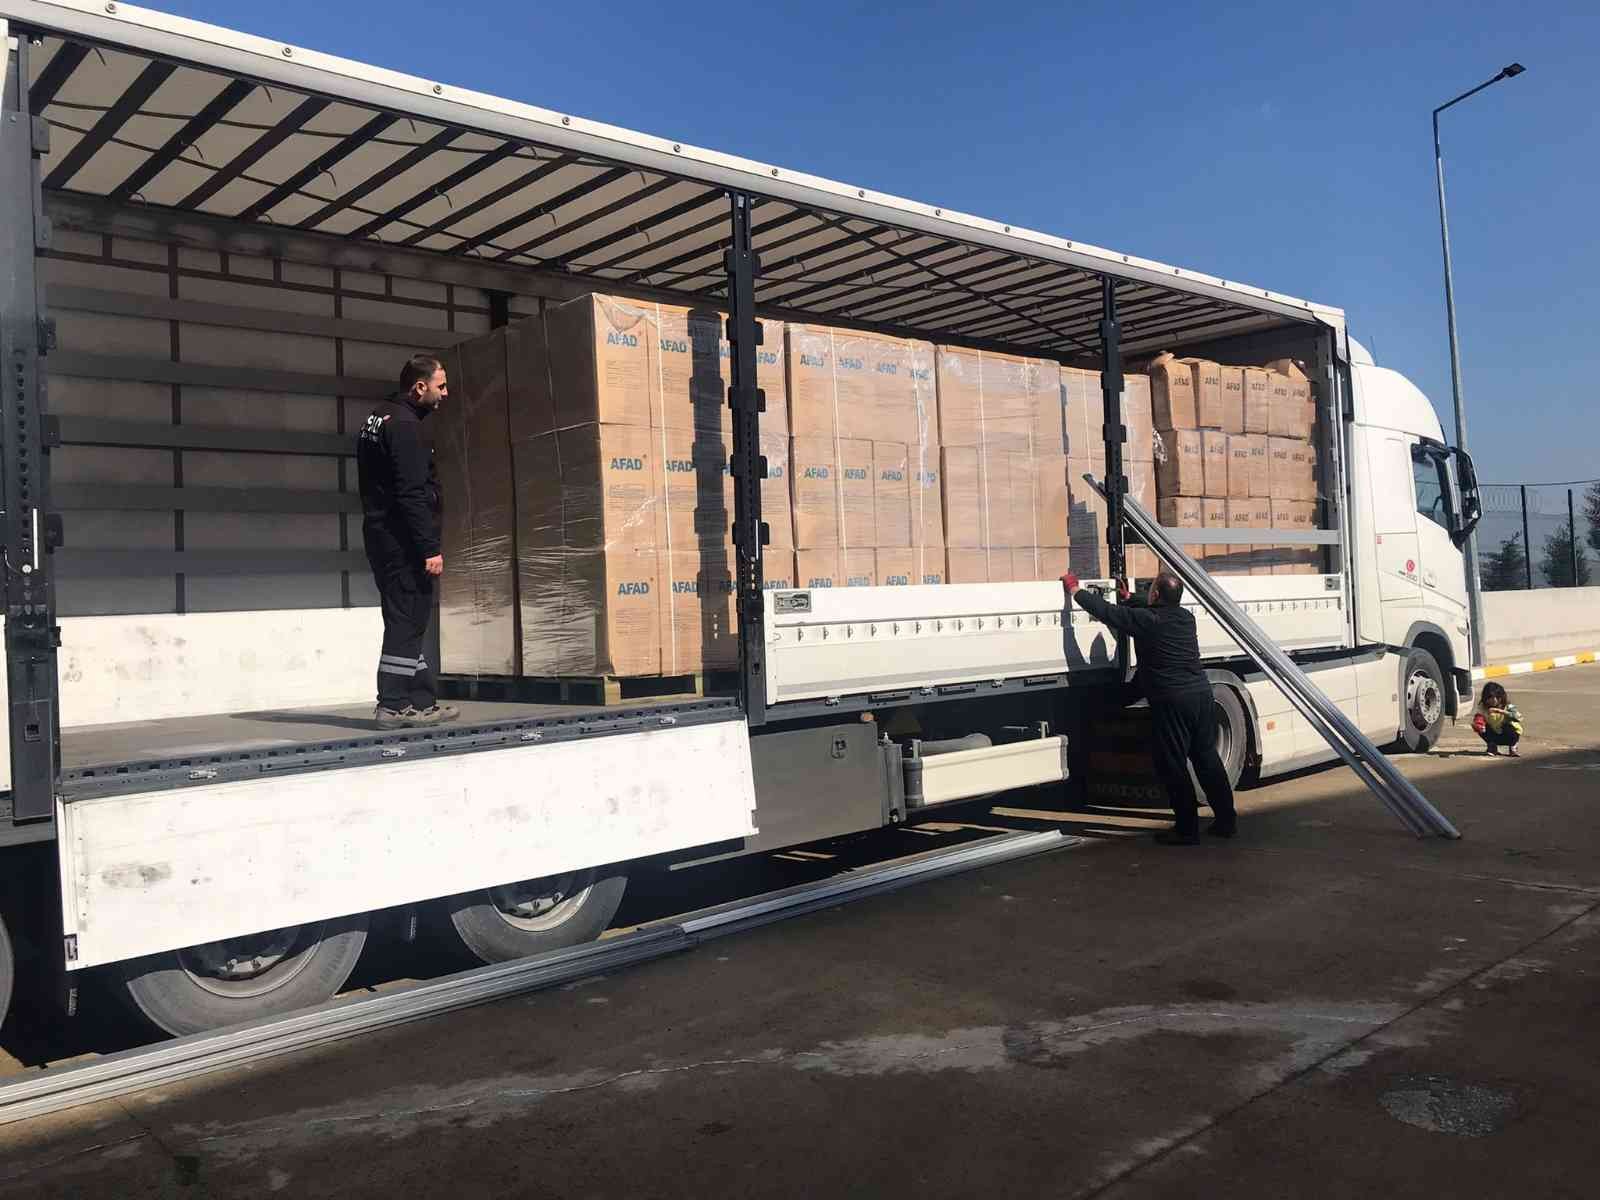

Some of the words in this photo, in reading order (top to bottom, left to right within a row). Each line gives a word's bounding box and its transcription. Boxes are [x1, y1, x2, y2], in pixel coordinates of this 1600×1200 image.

[607, 333, 637, 348] AFAD
[660, 339, 688, 353] AFAD
[757, 352, 776, 364] FAD
[611, 458, 642, 471] AFAD
[665, 460, 693, 472] AFAD
[804, 467, 829, 480] AFAD
[845, 468, 866, 480] AFAD
[881, 471, 902, 481] AFAD
[808, 578, 833, 589] AFAD
[886, 574, 908, 586] AFAD
[618, 582, 649, 596] AFAD
[672, 581, 698, 593] AFAD
